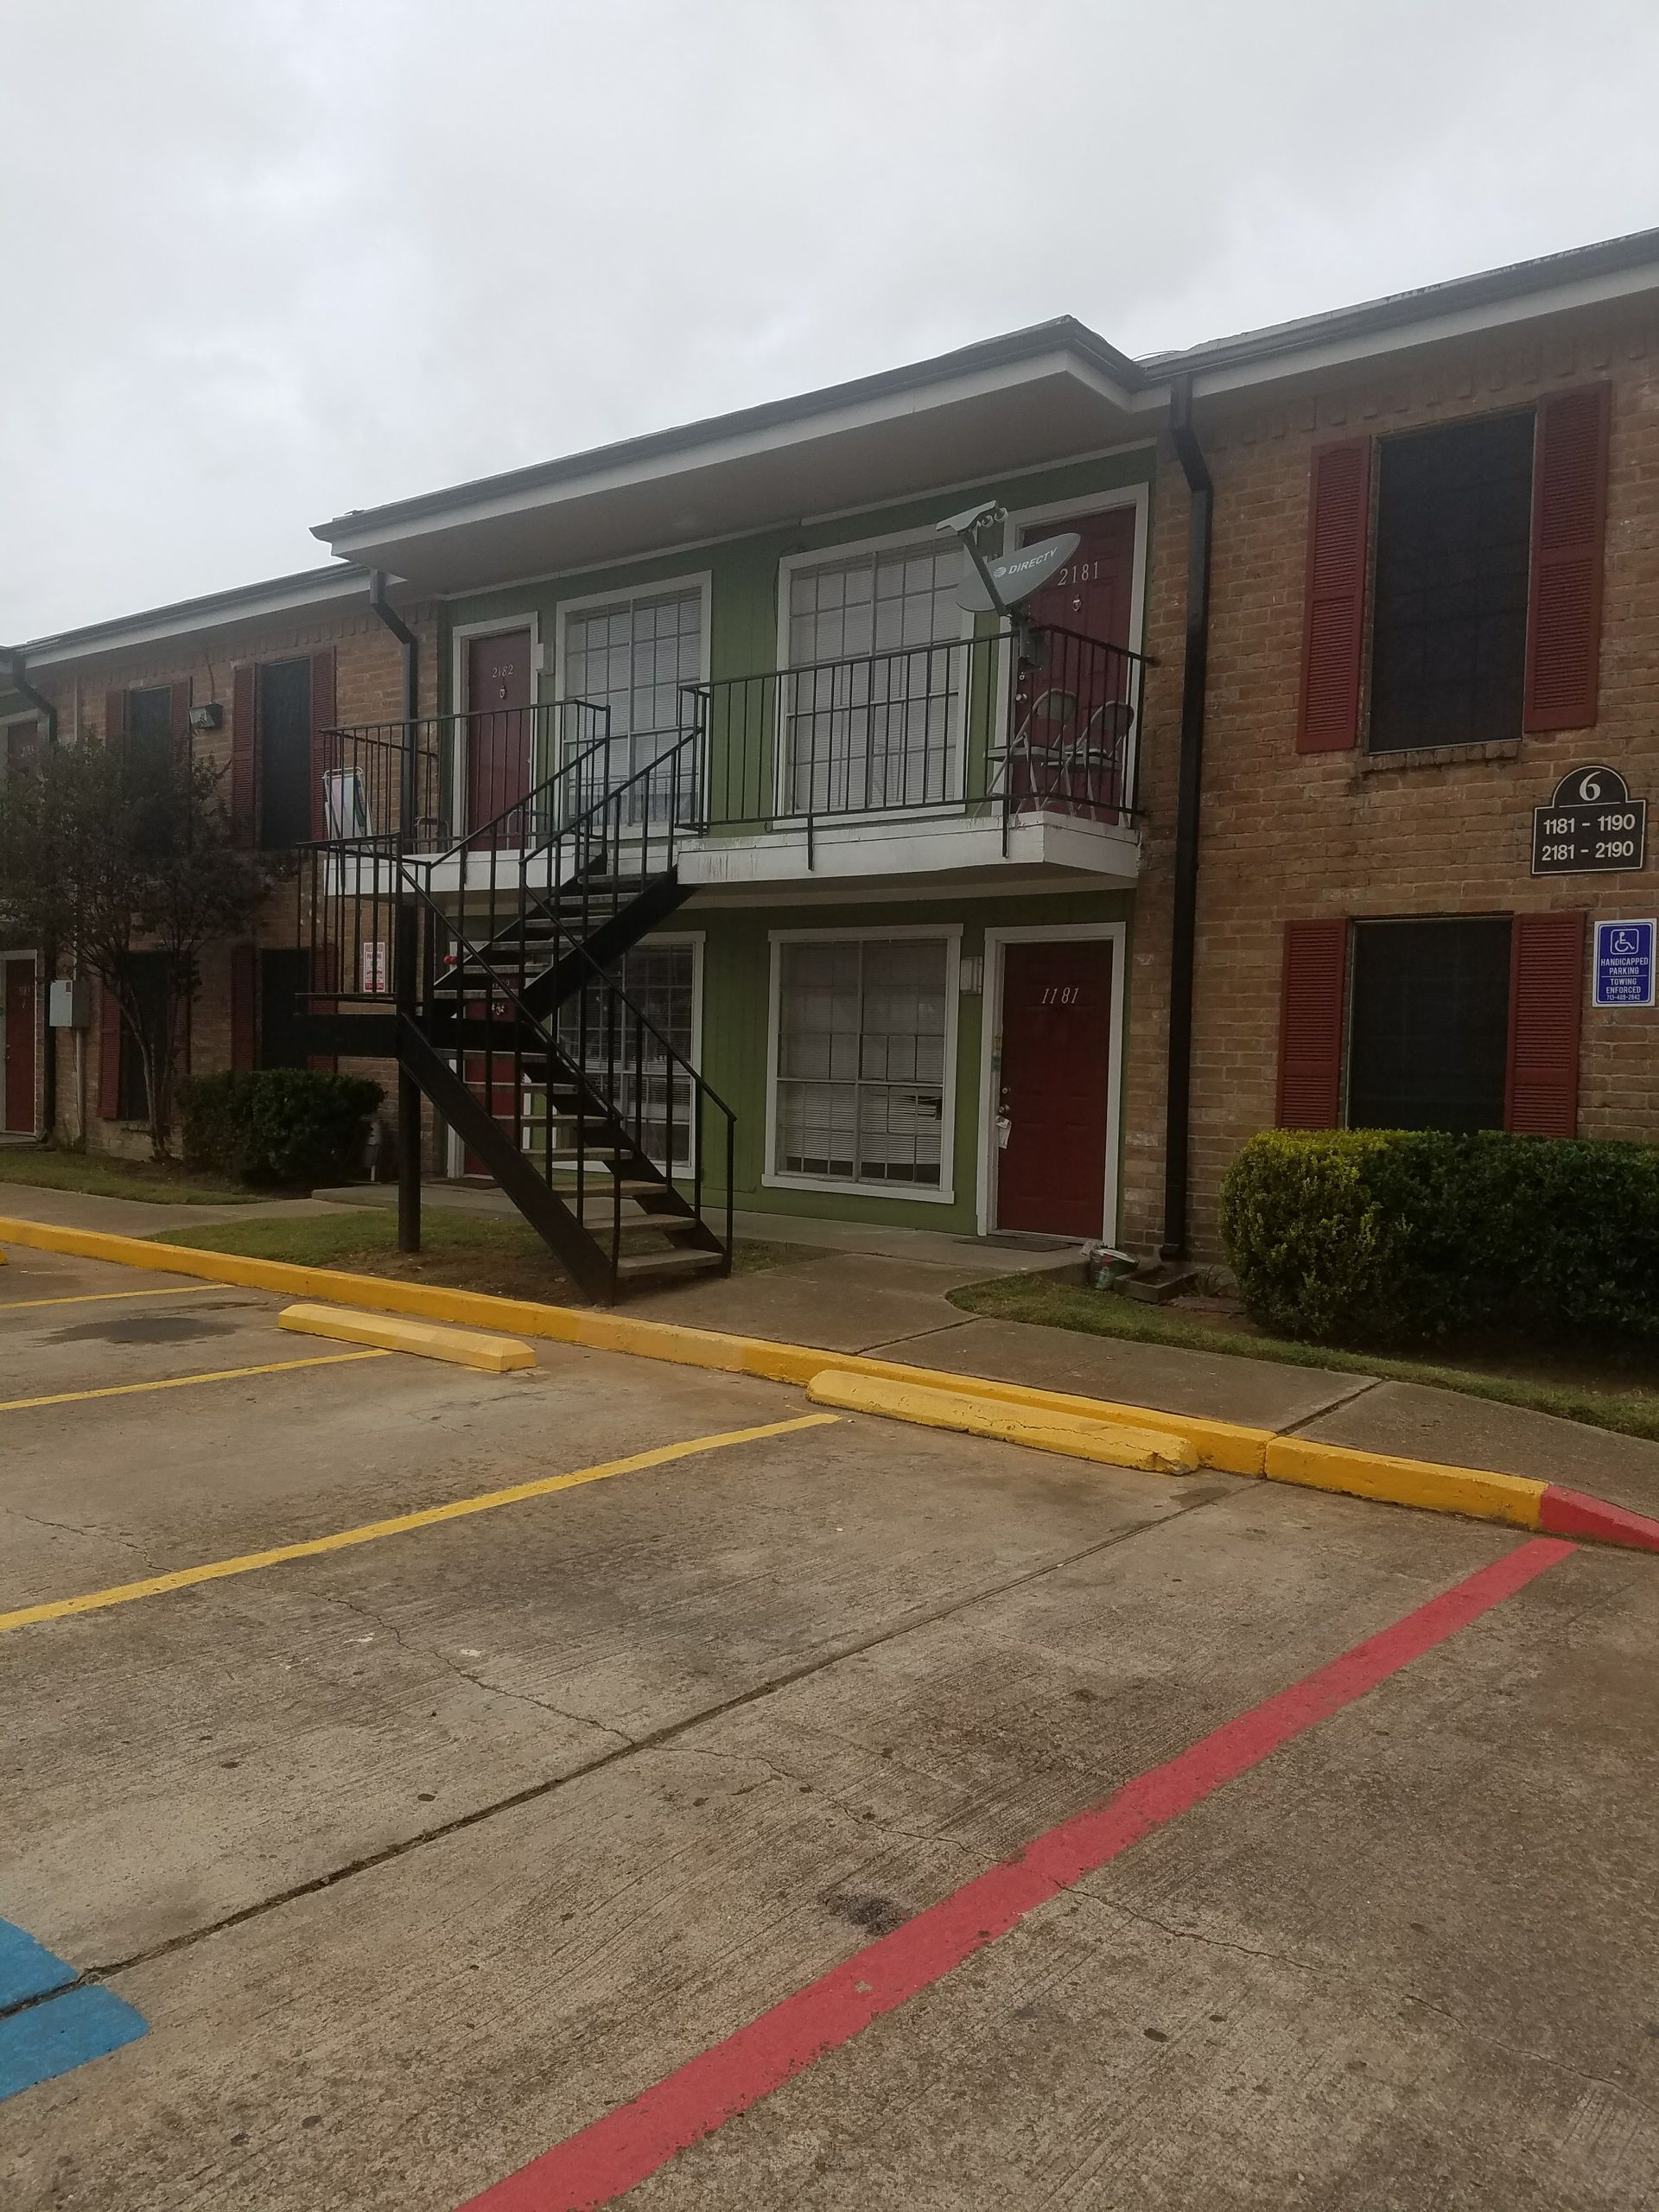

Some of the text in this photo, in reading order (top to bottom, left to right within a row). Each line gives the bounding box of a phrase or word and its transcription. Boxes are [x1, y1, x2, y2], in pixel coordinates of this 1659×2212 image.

[1007, 546, 1058, 575] DIRECTV
[1057, 561, 1099, 586] 2181
[492, 664, 513, 678] 2182
[1579, 771, 1602, 802] 6
[1543, 817, 1575, 835] 1181
[1597, 813, 1636, 831] 1190
[1541, 844, 1574, 861] 2181
[1595, 840, 1634, 858] 2190
[1600, 957, 1649, 967] HANDICAPPED
[1609, 966, 1640, 976] PARKING
[1610, 977, 1637, 986] TOWING
[1041, 987, 1079, 1004] 1181
[1605, 986, 1642, 995] ENFORCED
